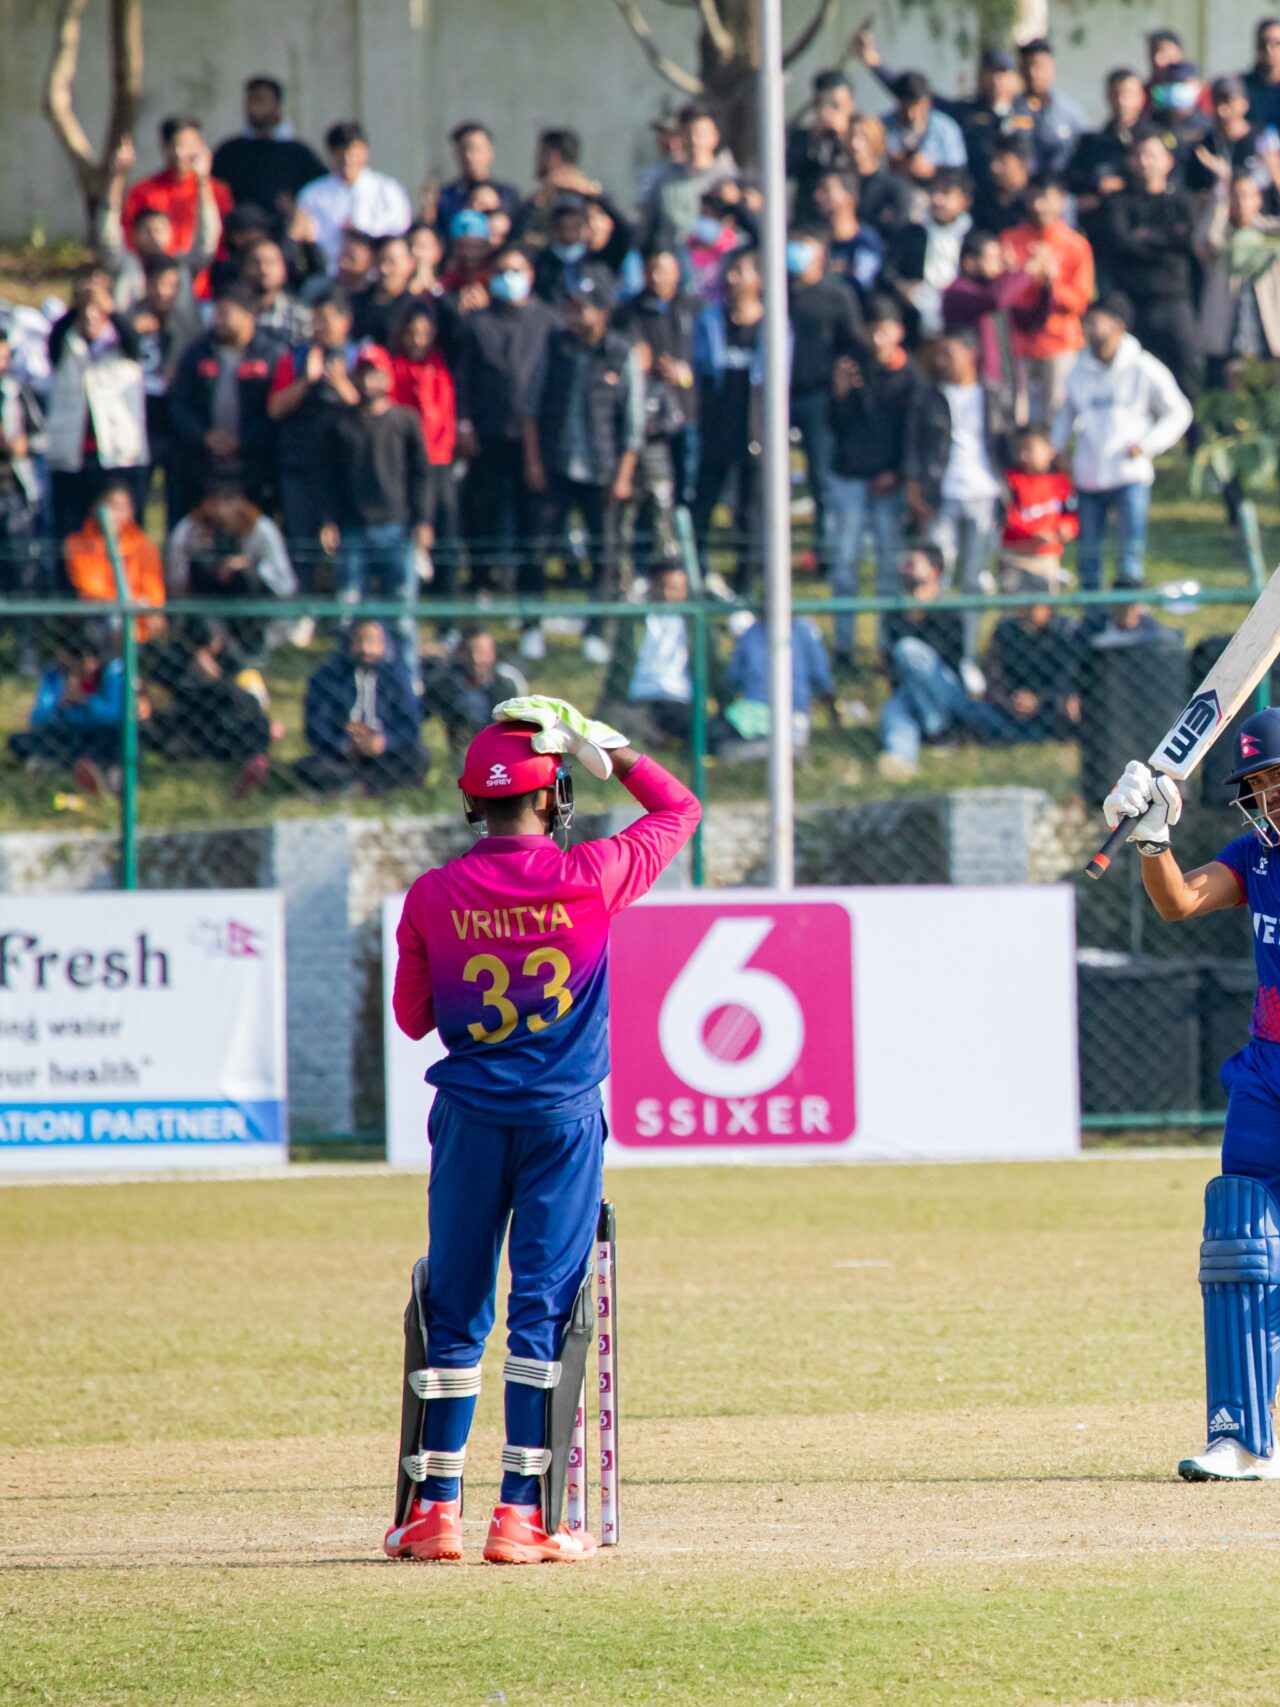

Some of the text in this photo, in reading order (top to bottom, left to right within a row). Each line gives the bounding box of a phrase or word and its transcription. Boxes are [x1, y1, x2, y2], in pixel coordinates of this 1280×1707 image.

[486, 778, 512, 787] SHREY
[451, 901, 574, 940] VRIITYA
[463, 947, 574, 1045] 33
[657, 915, 807, 1099] 6
[90, 1106, 248, 1141] PARTNER
[635, 1095, 832, 1137] SSIXER
